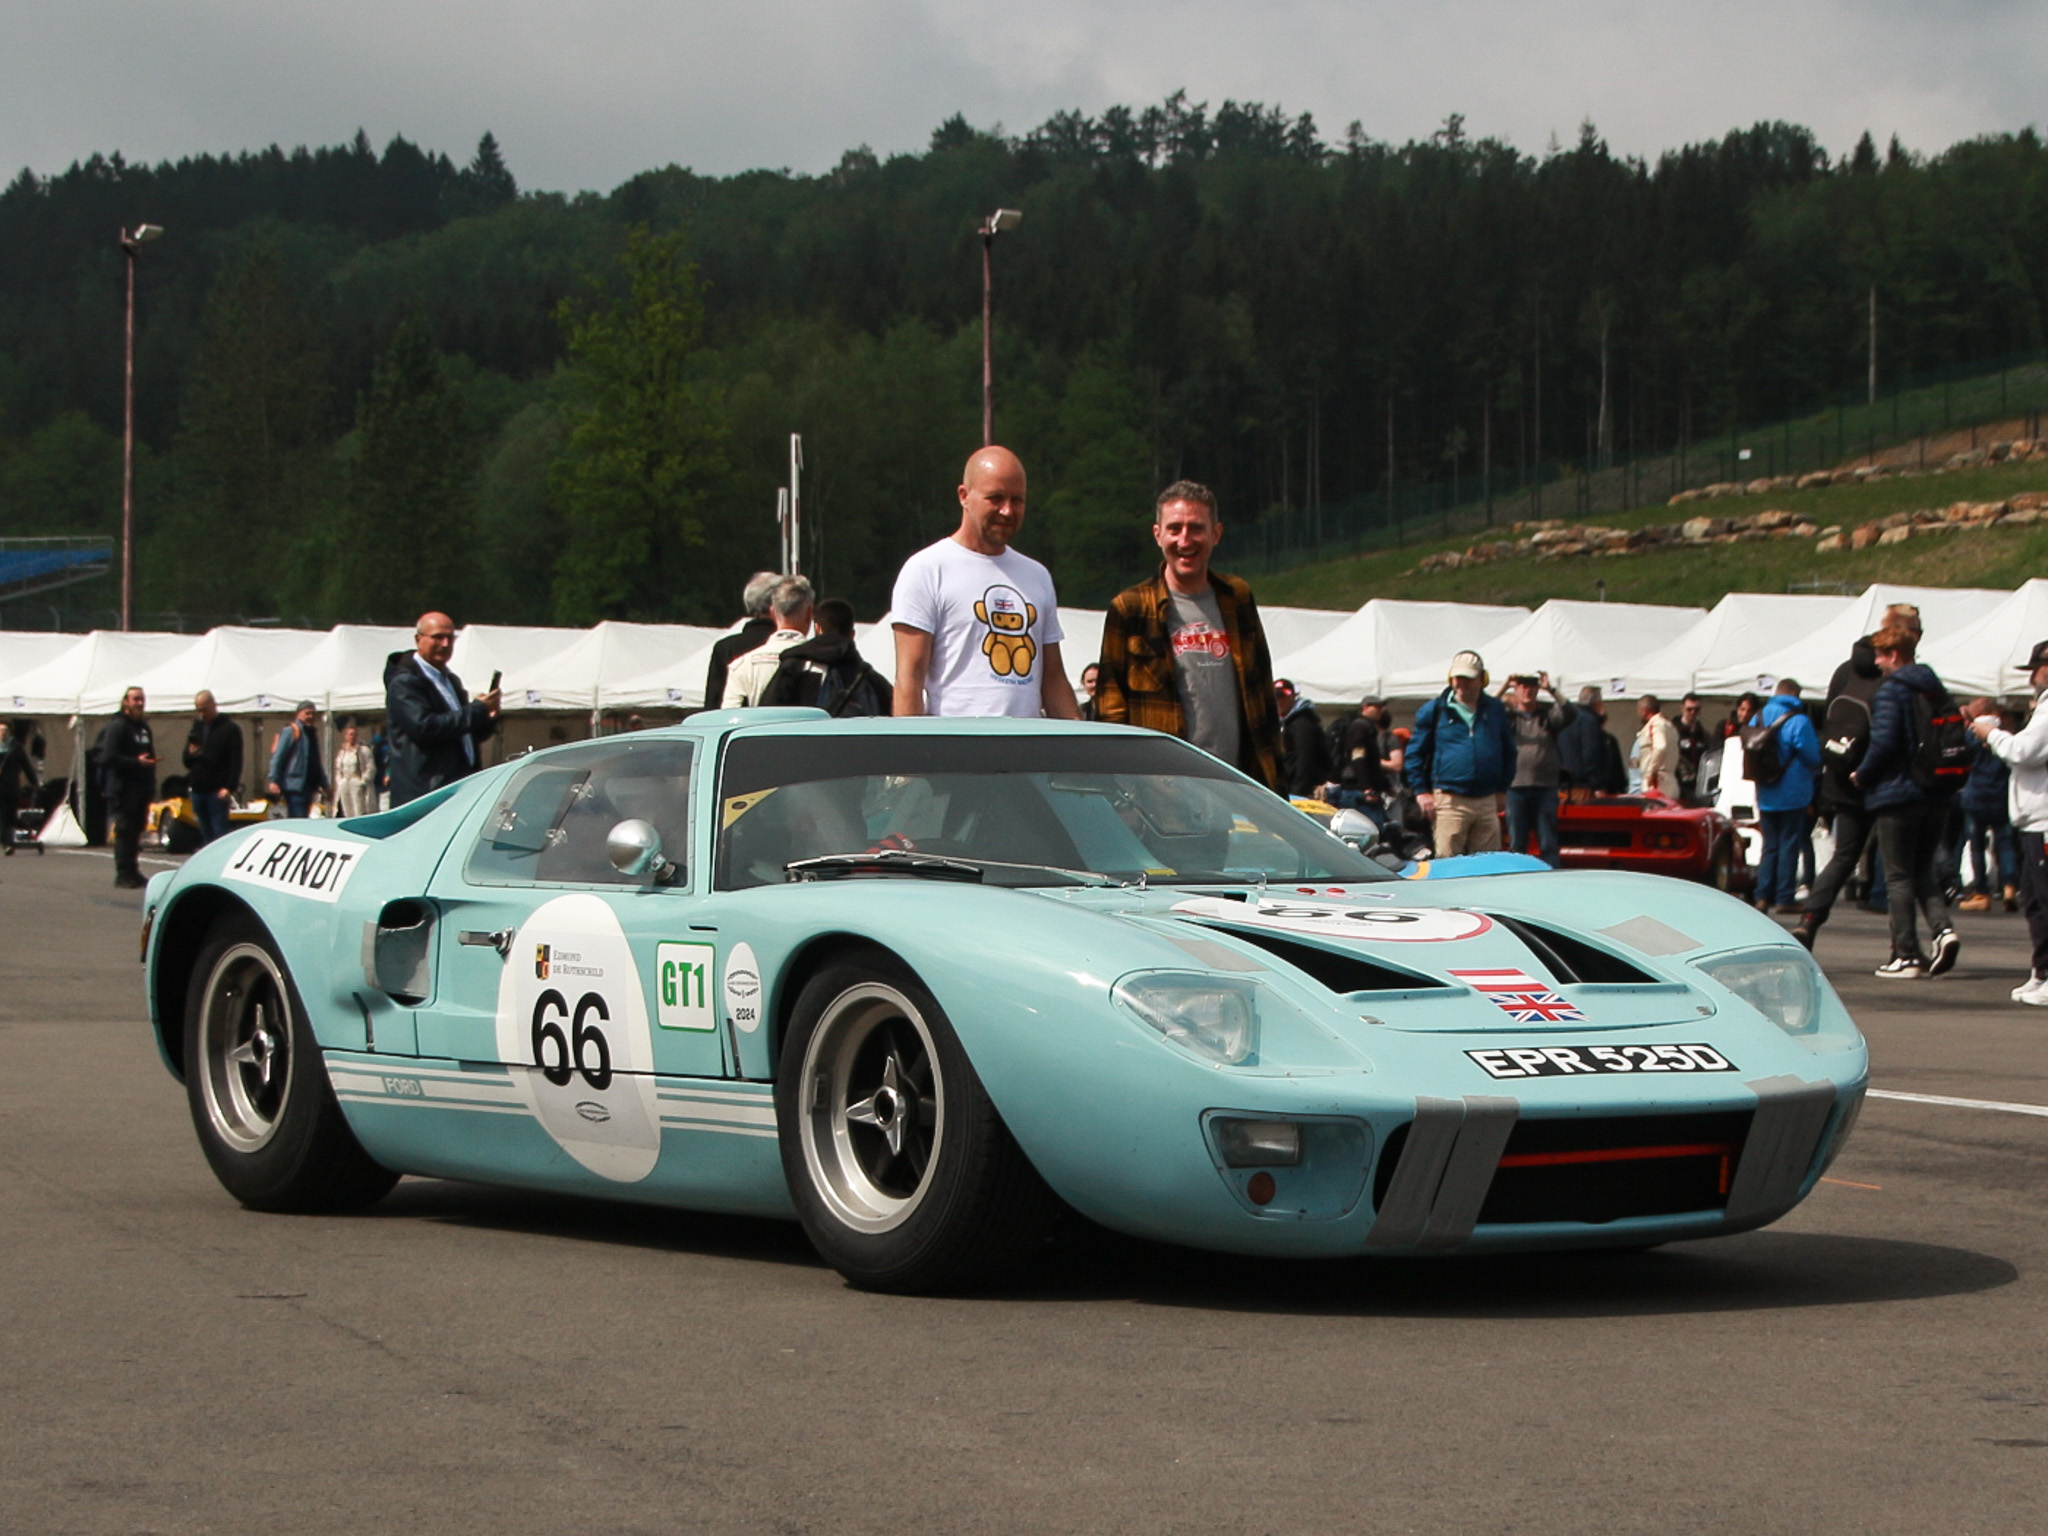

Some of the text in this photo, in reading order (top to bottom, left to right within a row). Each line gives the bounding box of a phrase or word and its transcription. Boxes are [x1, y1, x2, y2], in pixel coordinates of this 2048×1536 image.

[234, 838, 354, 892] J. RINDT
[1258, 905, 1427, 923] 66
[662, 960, 705, 1008] GT1
[736, 1007, 756, 1021] 2024
[531, 988, 613, 1091] 66
[1468, 1045, 1730, 1077] EPR 525D
[385, 1077, 421, 1096] FORD
